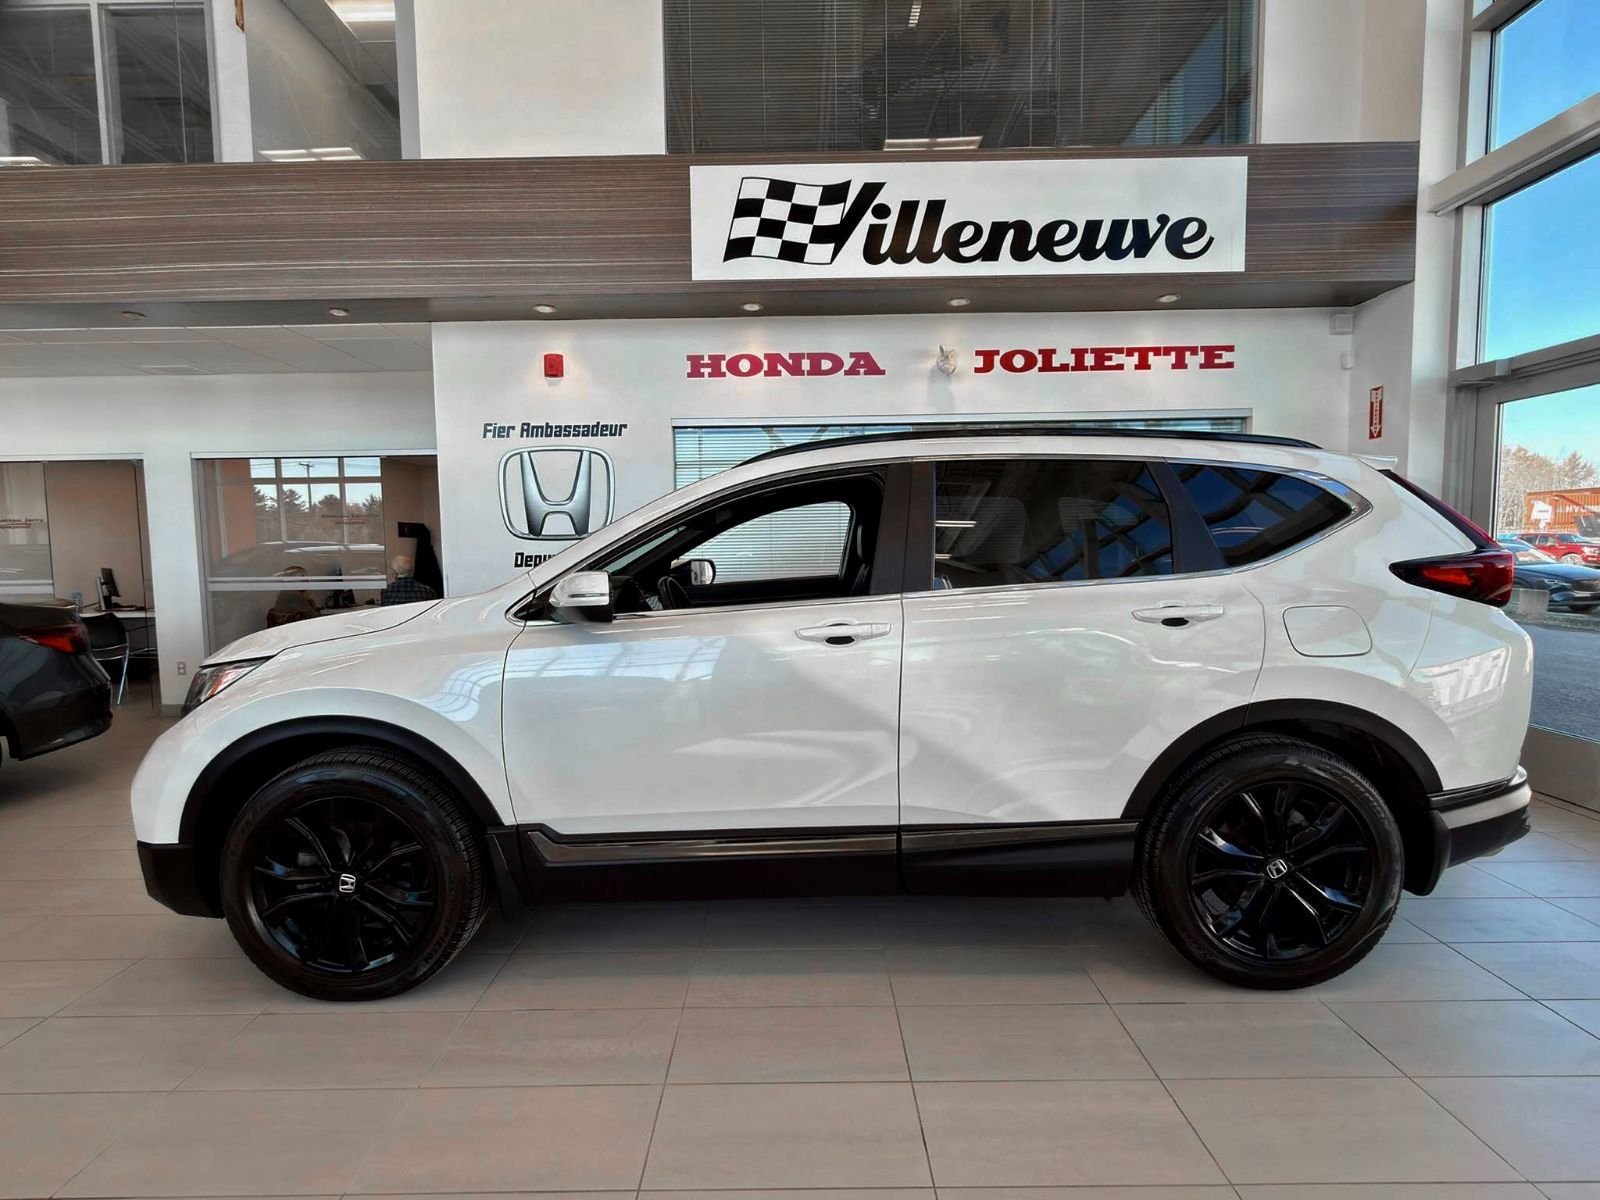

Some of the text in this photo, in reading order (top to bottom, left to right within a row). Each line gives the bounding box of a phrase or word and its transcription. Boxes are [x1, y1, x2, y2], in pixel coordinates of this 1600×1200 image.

[824, 179, 1215, 266] Villeneuve
[687, 345, 1235, 378] HONDA JOLIETTE
[482, 421, 628, 439] Fier Ambassadeur
